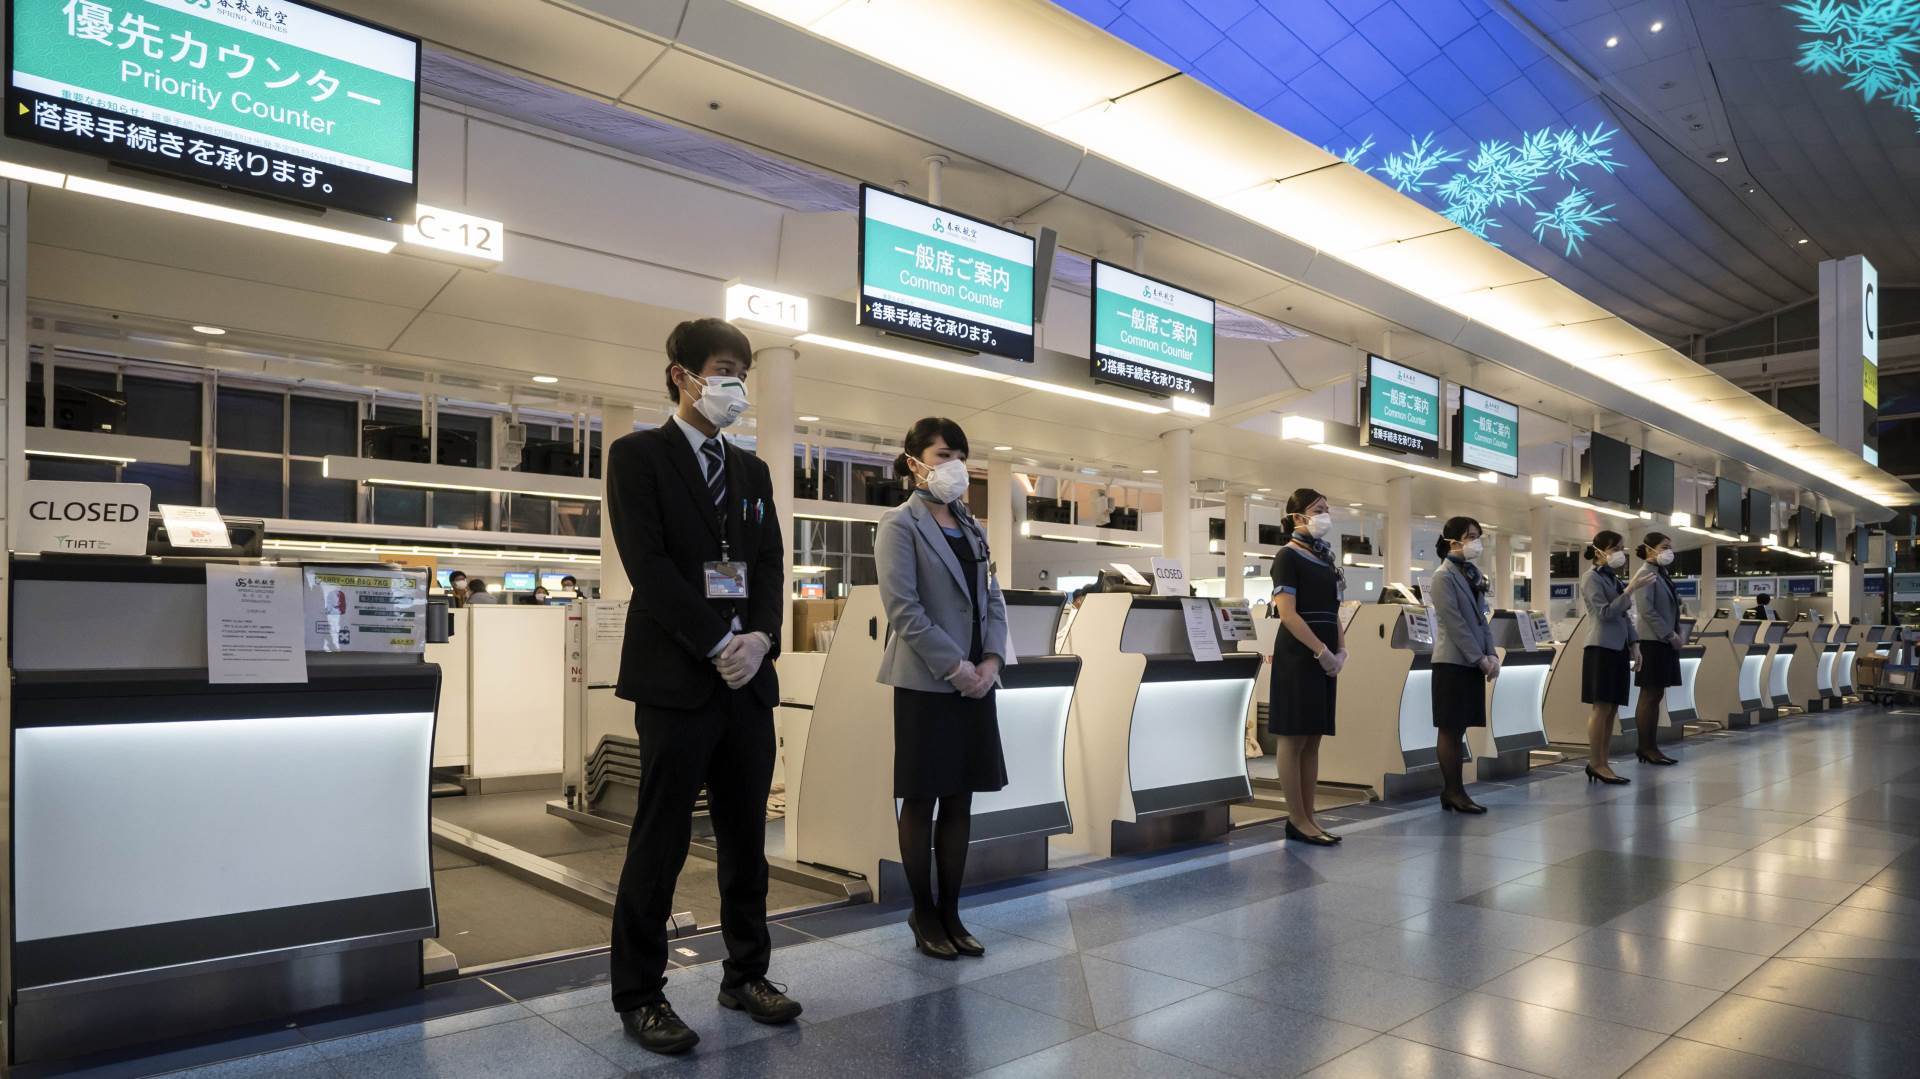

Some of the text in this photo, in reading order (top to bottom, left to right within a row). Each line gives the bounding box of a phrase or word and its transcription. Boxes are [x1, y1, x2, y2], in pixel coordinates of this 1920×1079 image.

[217, 8, 288, 33] SPRING AIRLINES
[62, 0, 382, 106] 優先カウンター
[120, 60, 336, 137] Priority Counter
[416, 213, 492, 251] C-12
[894, 243, 1010, 293] 一般席ご案内
[899, 269, 1005, 309] Common Counter
[746, 294, 798, 323] C-11
[1865, 282, 1874, 340] C
[1116, 308, 1198, 347] 一般席ご案内
[1120, 330, 1194, 361] Common Counter
[1382, 387, 1430, 415] 一般席ご案内
[1383, 406, 1427, 426] Common Counter
[29, 501, 139, 522] CLOSED
[65, 539, 97, 549] TIAT
[1156, 567, 1183, 580] CLOSED
